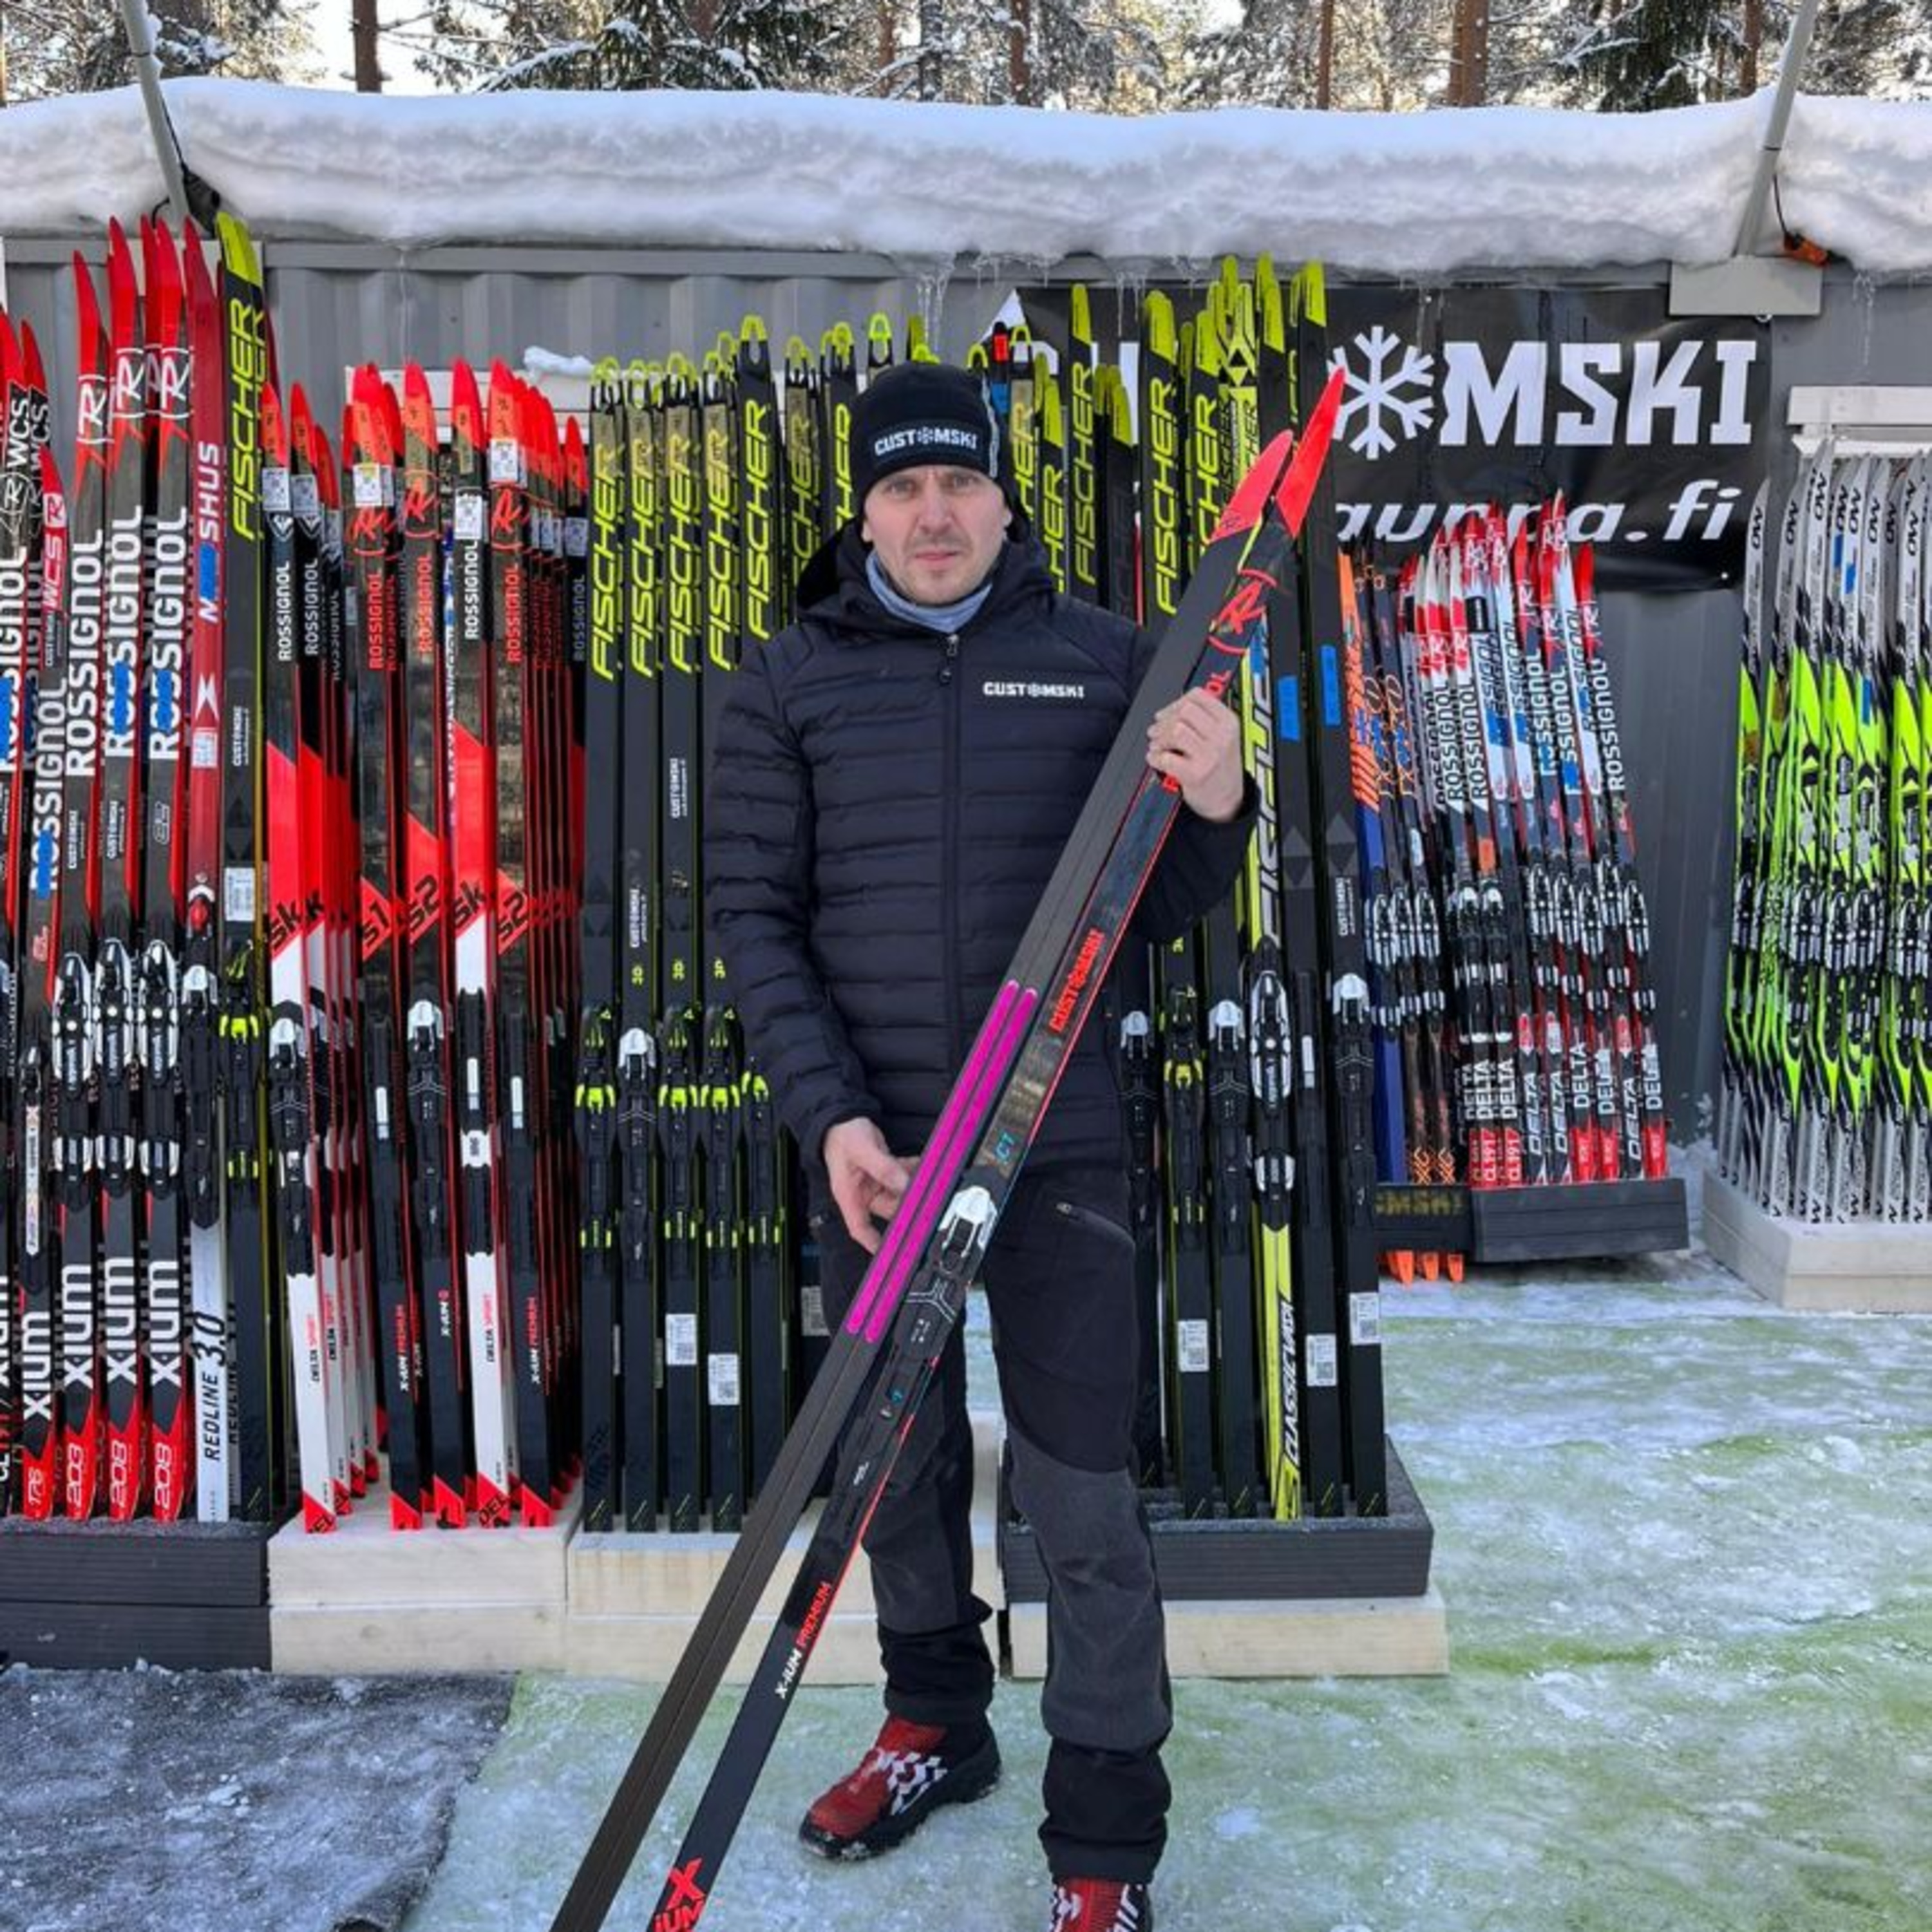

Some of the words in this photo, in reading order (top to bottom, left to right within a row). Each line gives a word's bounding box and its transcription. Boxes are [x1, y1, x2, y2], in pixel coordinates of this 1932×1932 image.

[7, 396, 30, 468] WCS
[230, 298, 256, 541] FISCHER
[1073, 361, 1096, 586] FISCHER
[198, 443, 220, 623] MSHUS
[707, 430, 732, 672] FISCHER
[746, 400, 772, 641] FISCHER
[1150, 377, 1178, 615] FISCHER
[44, 536, 62, 609] WCS
[465, 540, 480, 640] ROSSIGNOL
[592, 442, 618, 681] FISCHER
[630, 437, 654, 678] FISCHER
[668, 433, 693, 674] FISCHER
[66, 529, 103, 776] ROSSIGNOL
[279, 561, 293, 662] ROSSIGNOL
[1459, 682, 1489, 801] ROSSIGNOL
[1476, 1059, 1494, 1121] DELTA
[1498, 1057, 1519, 1119] DELTA
[1569, 1041, 1591, 1108] DELTA
[1621, 1076, 1640, 1160] DELTA
[191, 1311, 226, 1368] 3.0
[202, 1371, 220, 1461] REDLINE
[796, 1581, 834, 1649] PREMIUM
